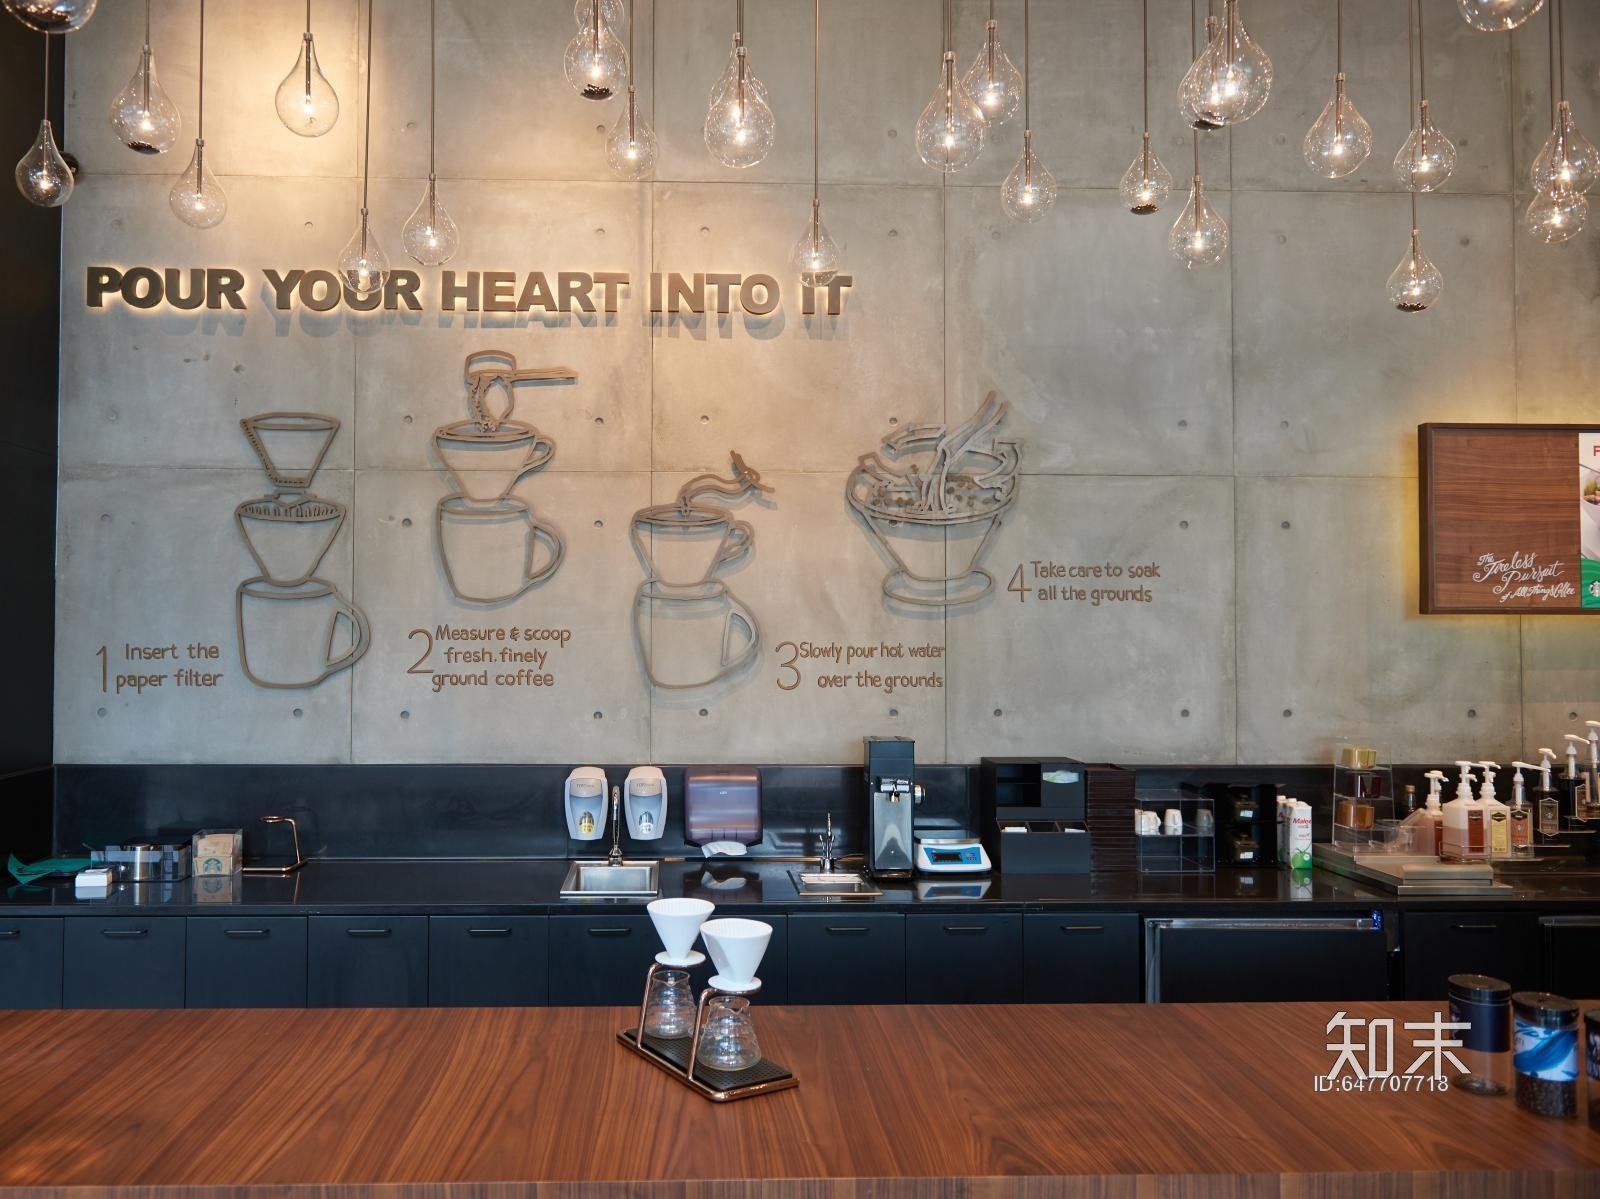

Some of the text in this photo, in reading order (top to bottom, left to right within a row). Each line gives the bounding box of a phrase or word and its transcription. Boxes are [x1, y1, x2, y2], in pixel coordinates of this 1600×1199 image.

[85, 265, 853, 316] POUR YOUR HEART INTO IT
[1030, 560, 1161, 579] Take care to soak
[1007, 562, 1033, 603] 4
[1037, 584, 1153, 607] all the grounds
[435, 623, 572, 648] Measure & scoop
[125, 642, 220, 660] Insert the
[407, 628, 434, 674] 2
[500, 646, 548, 670] finely
[799, 641, 946, 665] Slowly pour hot water
[96, 645, 108, 693] 1
[775, 640, 801, 691] 3
[116, 668, 224, 695] paper filter
[432, 668, 554, 693] ground coffee
[817, 670, 944, 695] over the grounds
